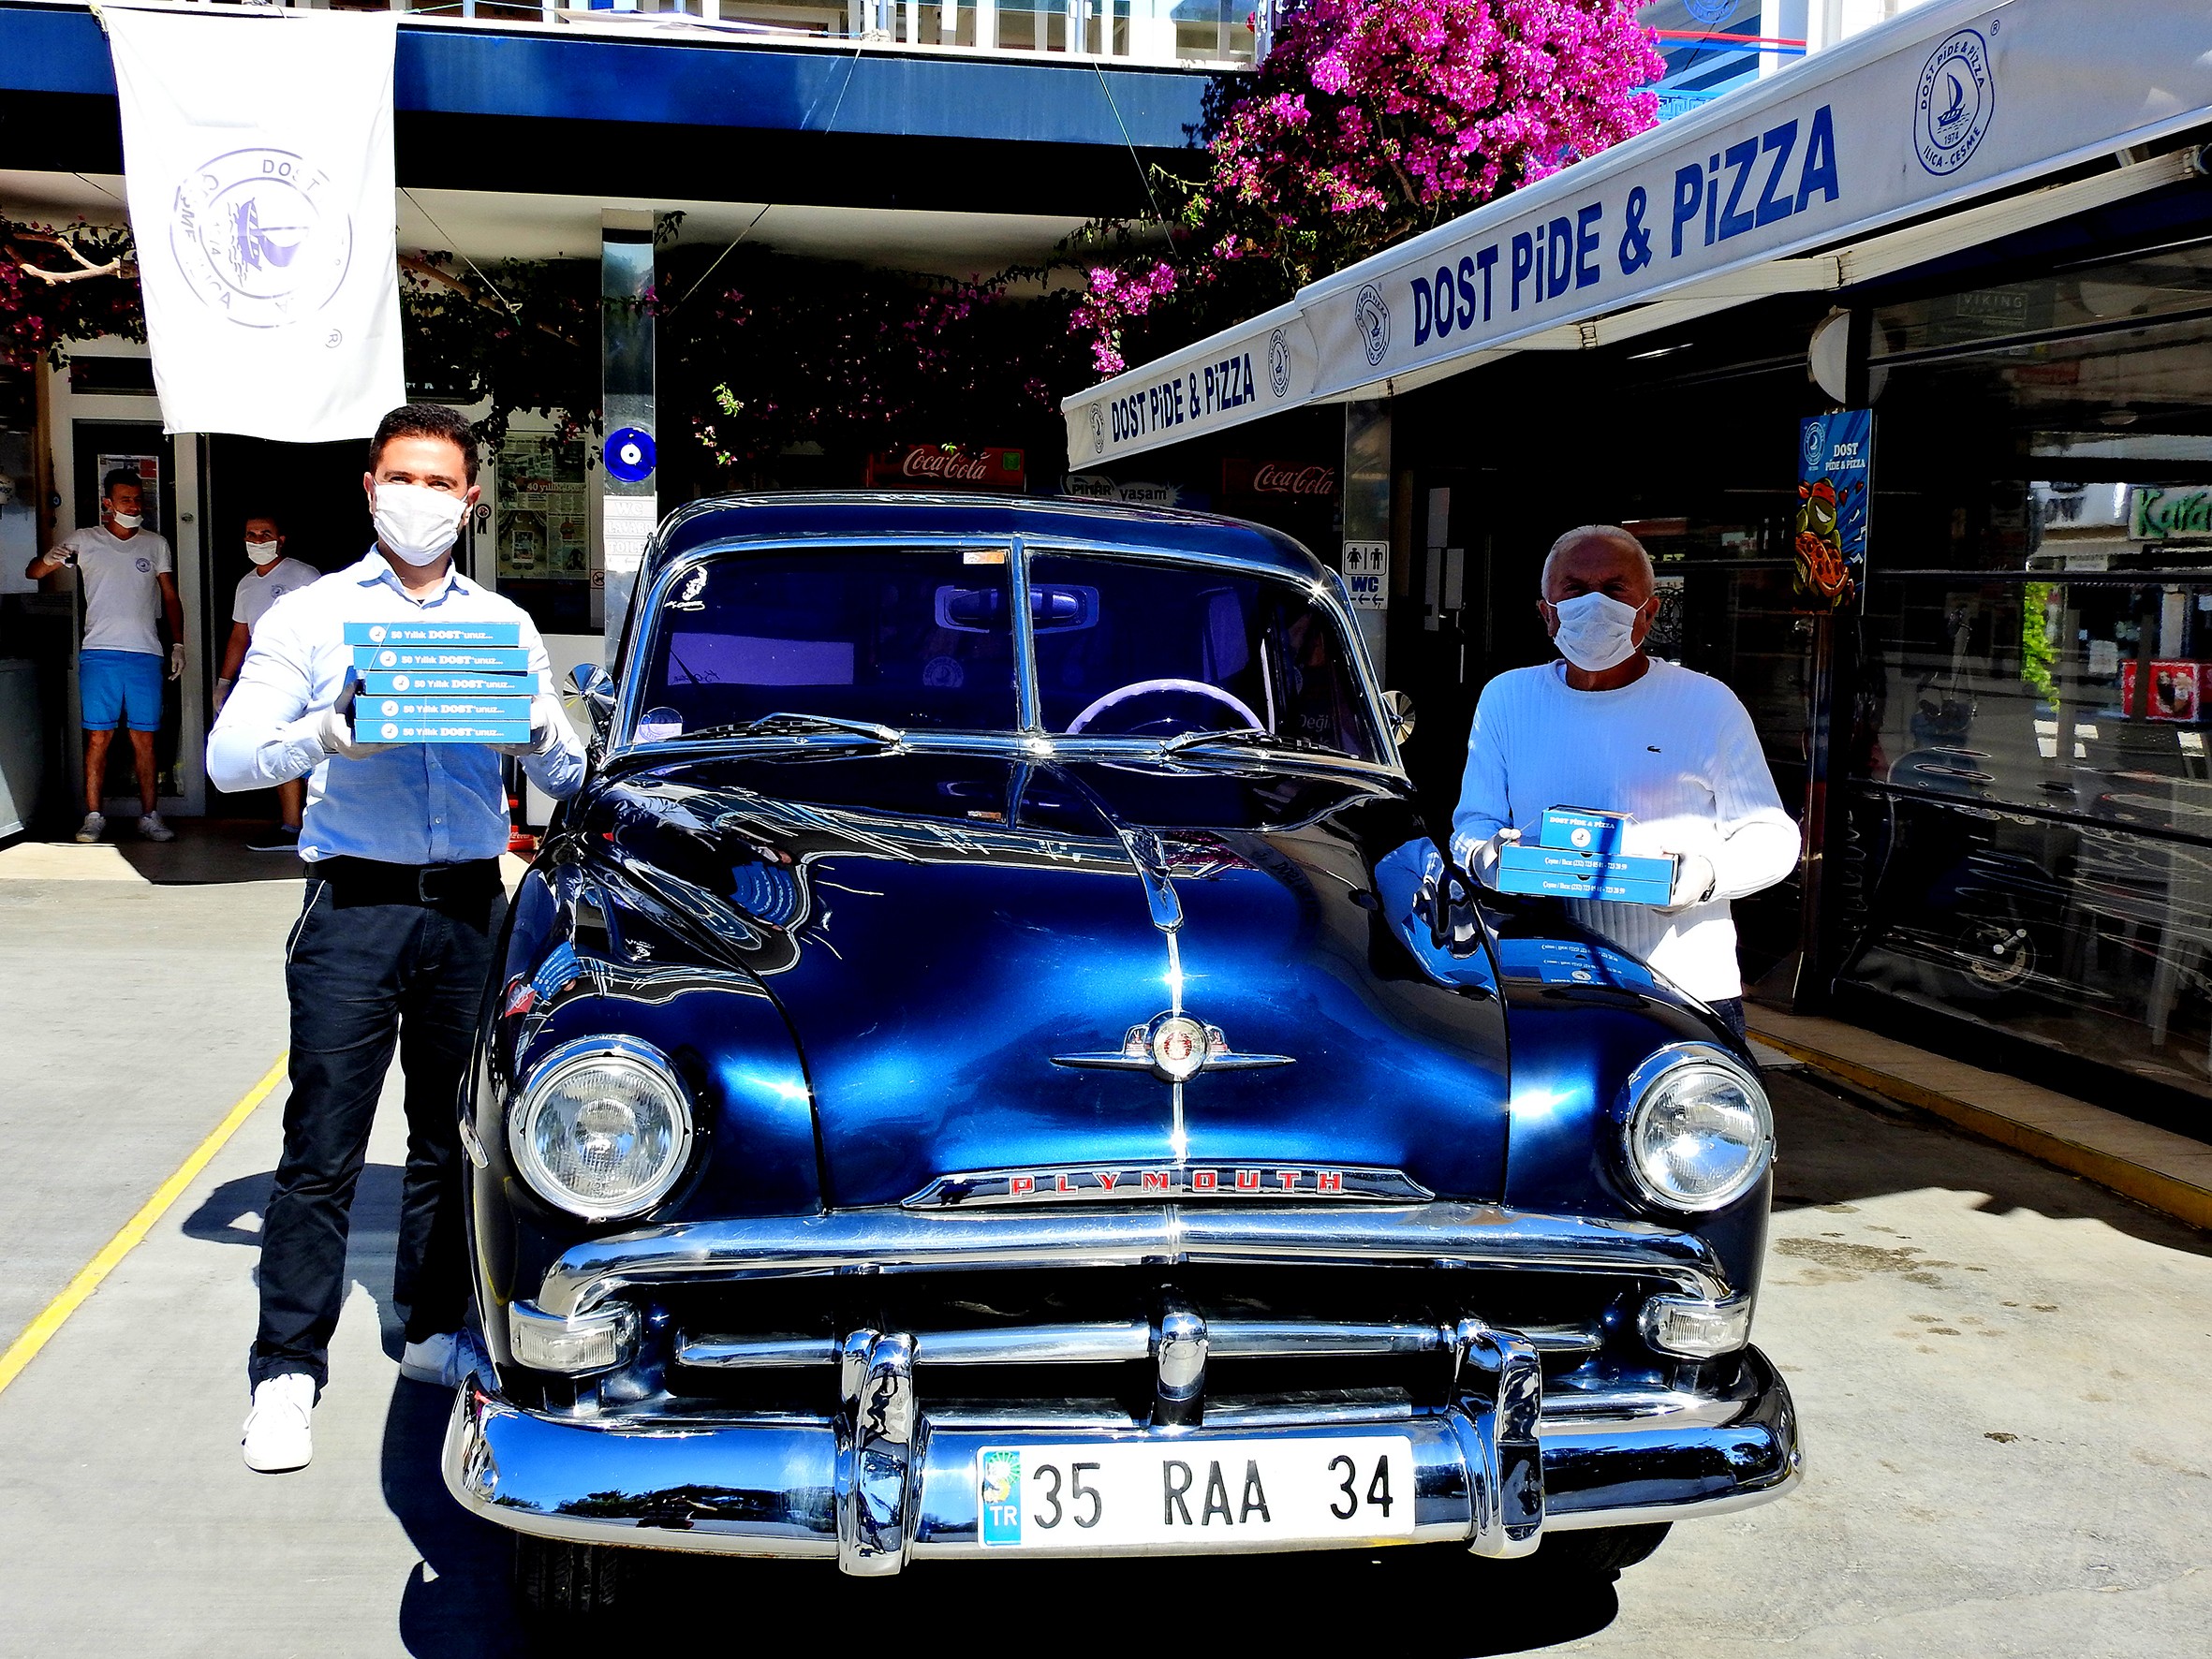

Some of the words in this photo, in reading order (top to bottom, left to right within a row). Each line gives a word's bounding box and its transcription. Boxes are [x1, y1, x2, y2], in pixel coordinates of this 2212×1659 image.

[1921, 64, 1936, 110] DOST
[1960, 40, 1969, 53] &
[1943, 130, 1960, 145] 1974
[1409, 243, 1499, 347] DOST
[1618, 185, 1653, 275] &
[1964, 294, 2023, 308] VIKING
[1111, 391, 1146, 443] DOST
[1189, 372, 1202, 420] &
[1833, 442, 1859, 458] DOST
[903, 448, 990, 479] Coca-Cola
[1254, 464, 1335, 494] Coca-Cola
[1119, 486, 1168, 504] yaşam
[614, 502, 643, 516] WC
[1350, 576, 1379, 593] WC
[391, 631, 403, 639] 50
[401, 655, 413, 664] 50
[403, 705, 414, 713] 50
[1009, 1170, 1343, 1197] PLYMOUTH
[1033, 1461, 1102, 1529] 35
[1162, 1459, 1271, 1526] RAA
[1328, 1454, 1394, 1520] 34
[989, 1505, 1019, 1526] TR
